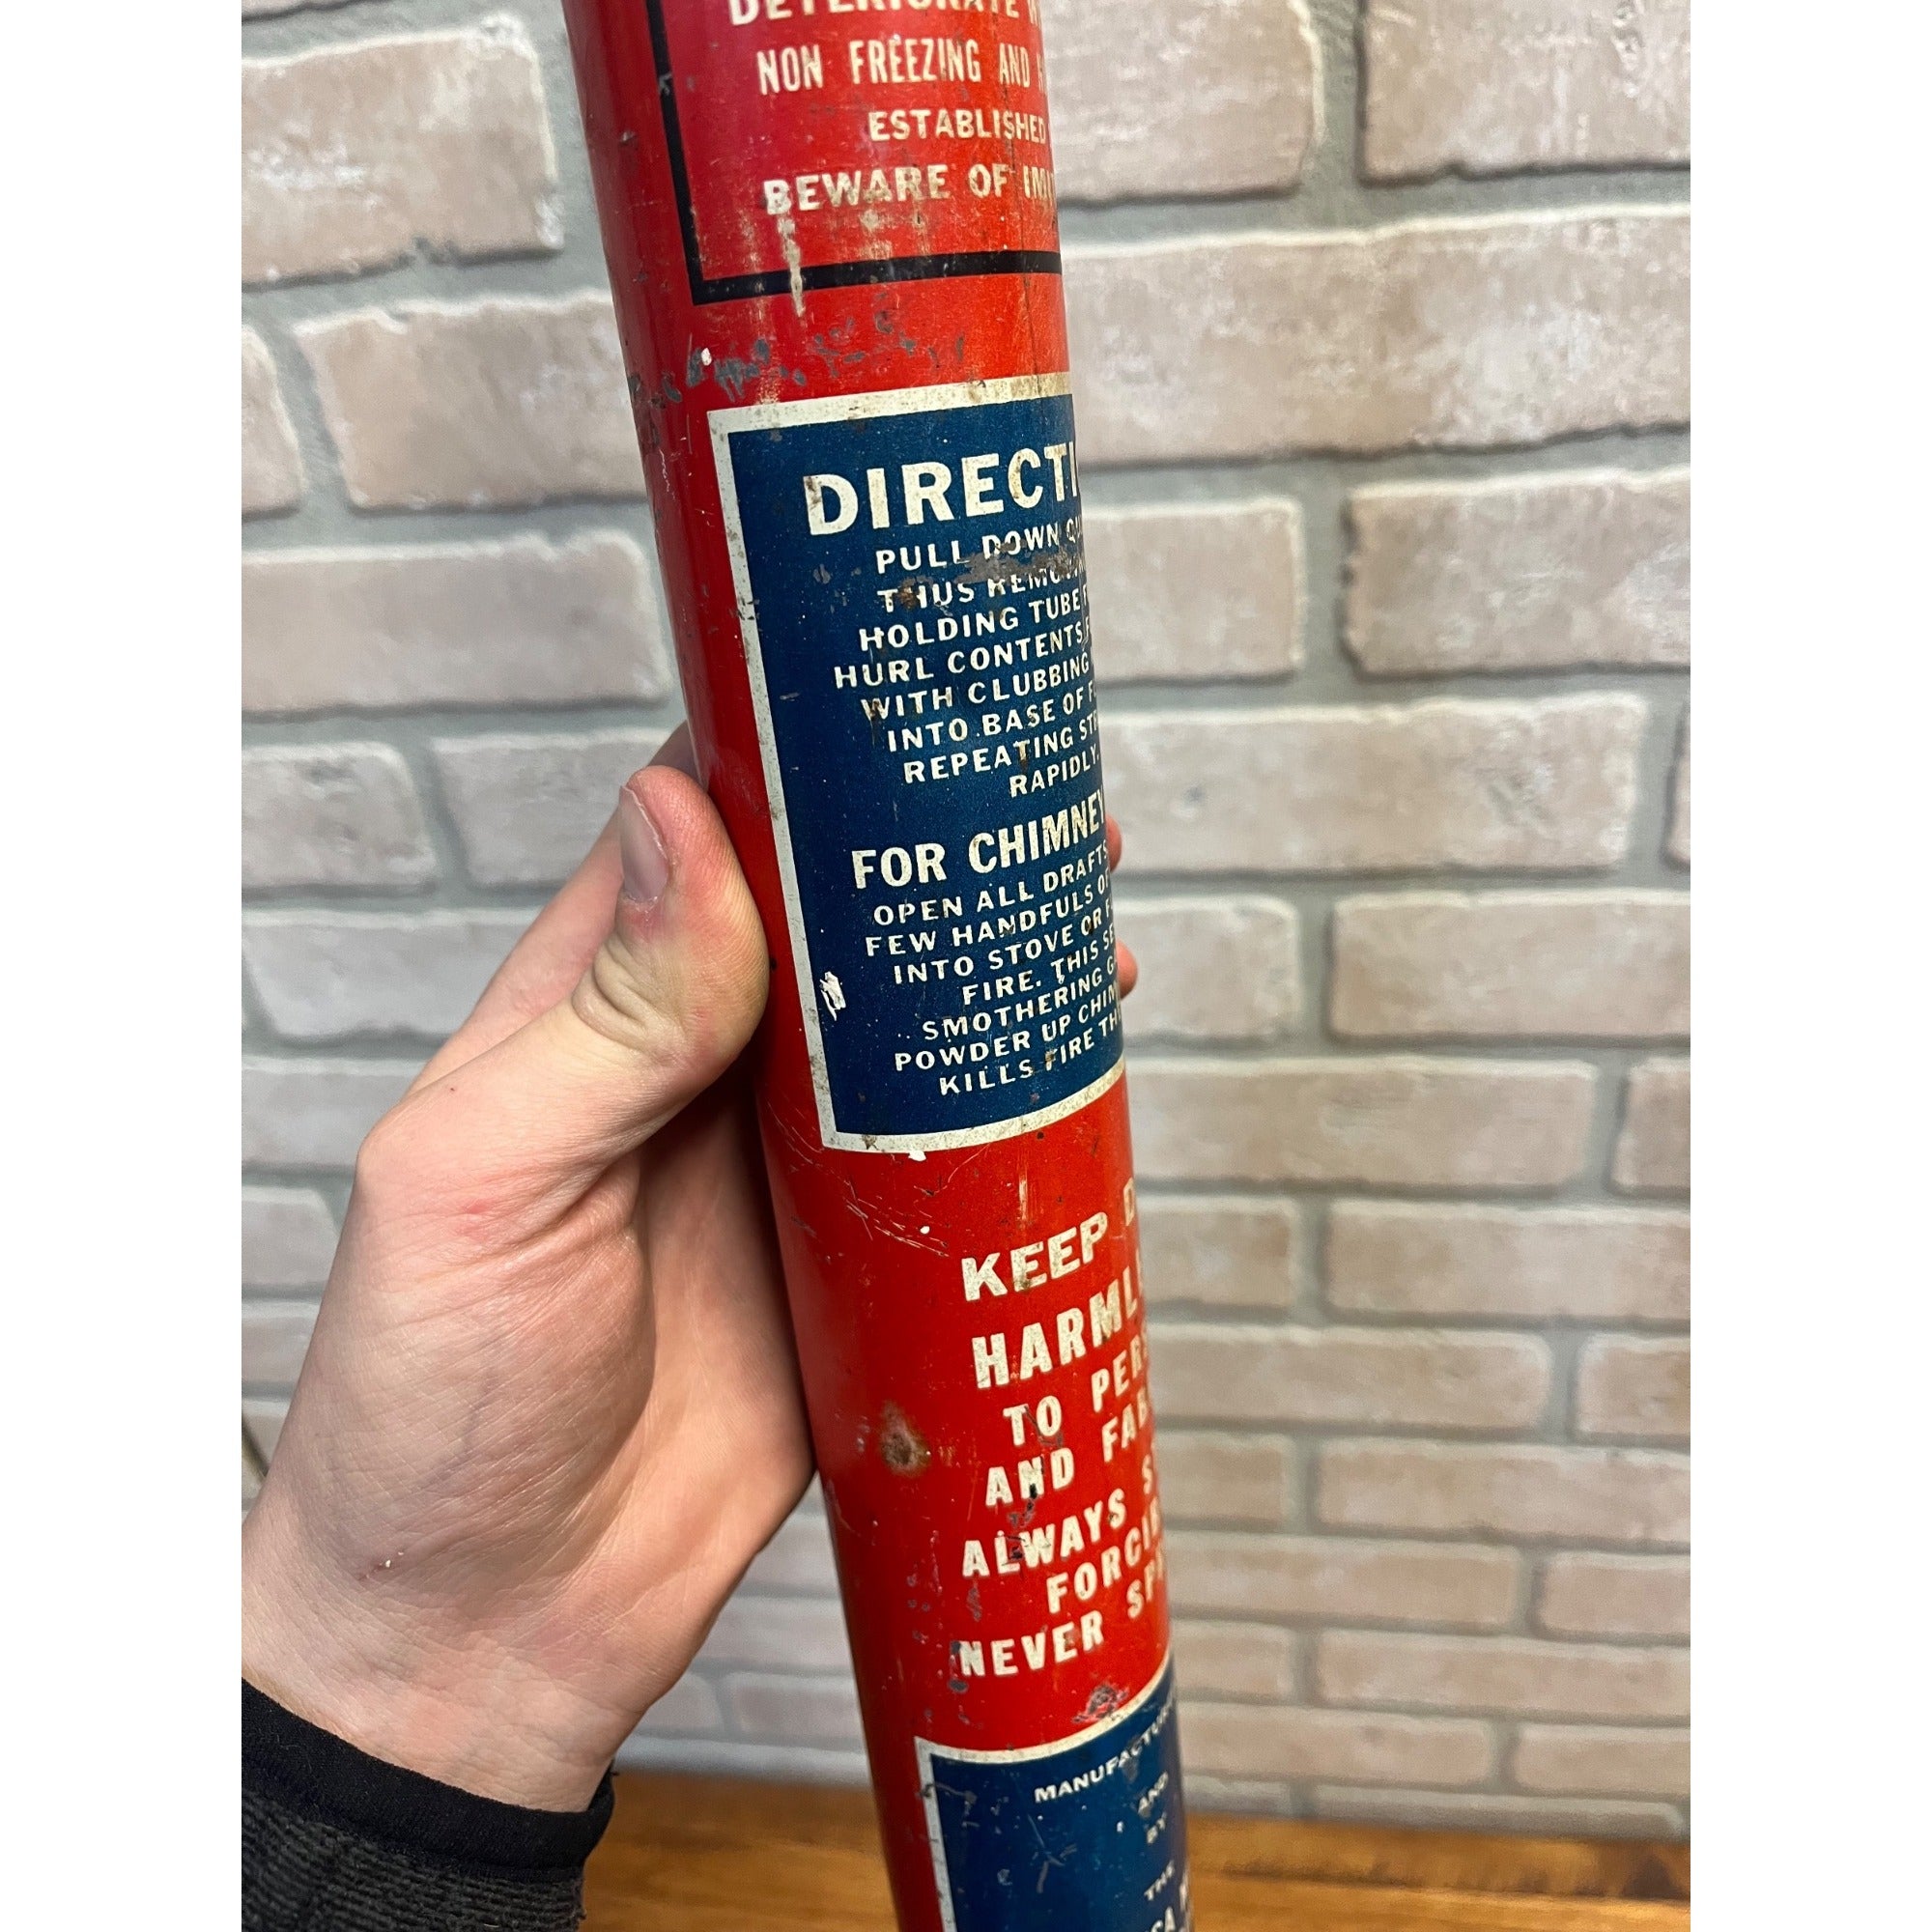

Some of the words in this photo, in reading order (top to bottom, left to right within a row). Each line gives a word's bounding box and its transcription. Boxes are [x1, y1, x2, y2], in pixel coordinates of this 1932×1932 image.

[757, 44, 824, 95] NON
[849, 39, 980, 84] FREEZING
[999, 43, 1031, 88] AND
[867, 109, 1046, 144] ESTABLISHED
[763, 164, 950, 214] BEWARE
[969, 164, 1009, 199] OF
[803, 440, 1078, 536] DIRECTI
[876, 540, 970, 574] PULL
[981, 526, 1060, 560] DOWN
[860, 606, 1019, 651] HOLDING
[1029, 590, 1081, 624] TUBE
[877, 580, 976, 612] THUS
[835, 657, 934, 689] HURL
[948, 621, 1083, 674] CONTENTS
[860, 686, 953, 723] WITH
[968, 656, 1090, 704] CLUBBING
[888, 718, 968, 753] INTO
[982, 698, 1056, 737] BASE
[1063, 690, 1085, 715] OF
[903, 724, 1074, 784] REPEATING
[1009, 743, 1099, 798] RAPIDLY.
[852, 842, 947, 890] FOR
[866, 929, 937, 956] FEW
[952, 889, 1094, 947] HANDFULS
[873, 895, 963, 925] OPEN
[976, 880, 1035, 911] ALL
[894, 955, 975, 983] INTO
[989, 927, 1074, 971] STOVE
[1080, 910, 1103, 936] OR
[1051, 938, 1100, 983] THIS
[922, 966, 1103, 1040] SMOTHERING
[895, 1030, 1031, 1071] POWDER
[1042, 1014, 1069, 1041] UP
[939, 1059, 1035, 1096] KILLS
[1045, 1029, 1094, 1071] FIRE
[962, 1211, 1109, 1302] KEEP
[972, 1249, 1143, 1389] HARML
[1004, 1394, 1063, 1446] TO
[985, 1448, 1075, 1507] AND
[963, 1489, 1126, 1578] ALWAYS
[958, 1609, 1104, 1678] NEVER
